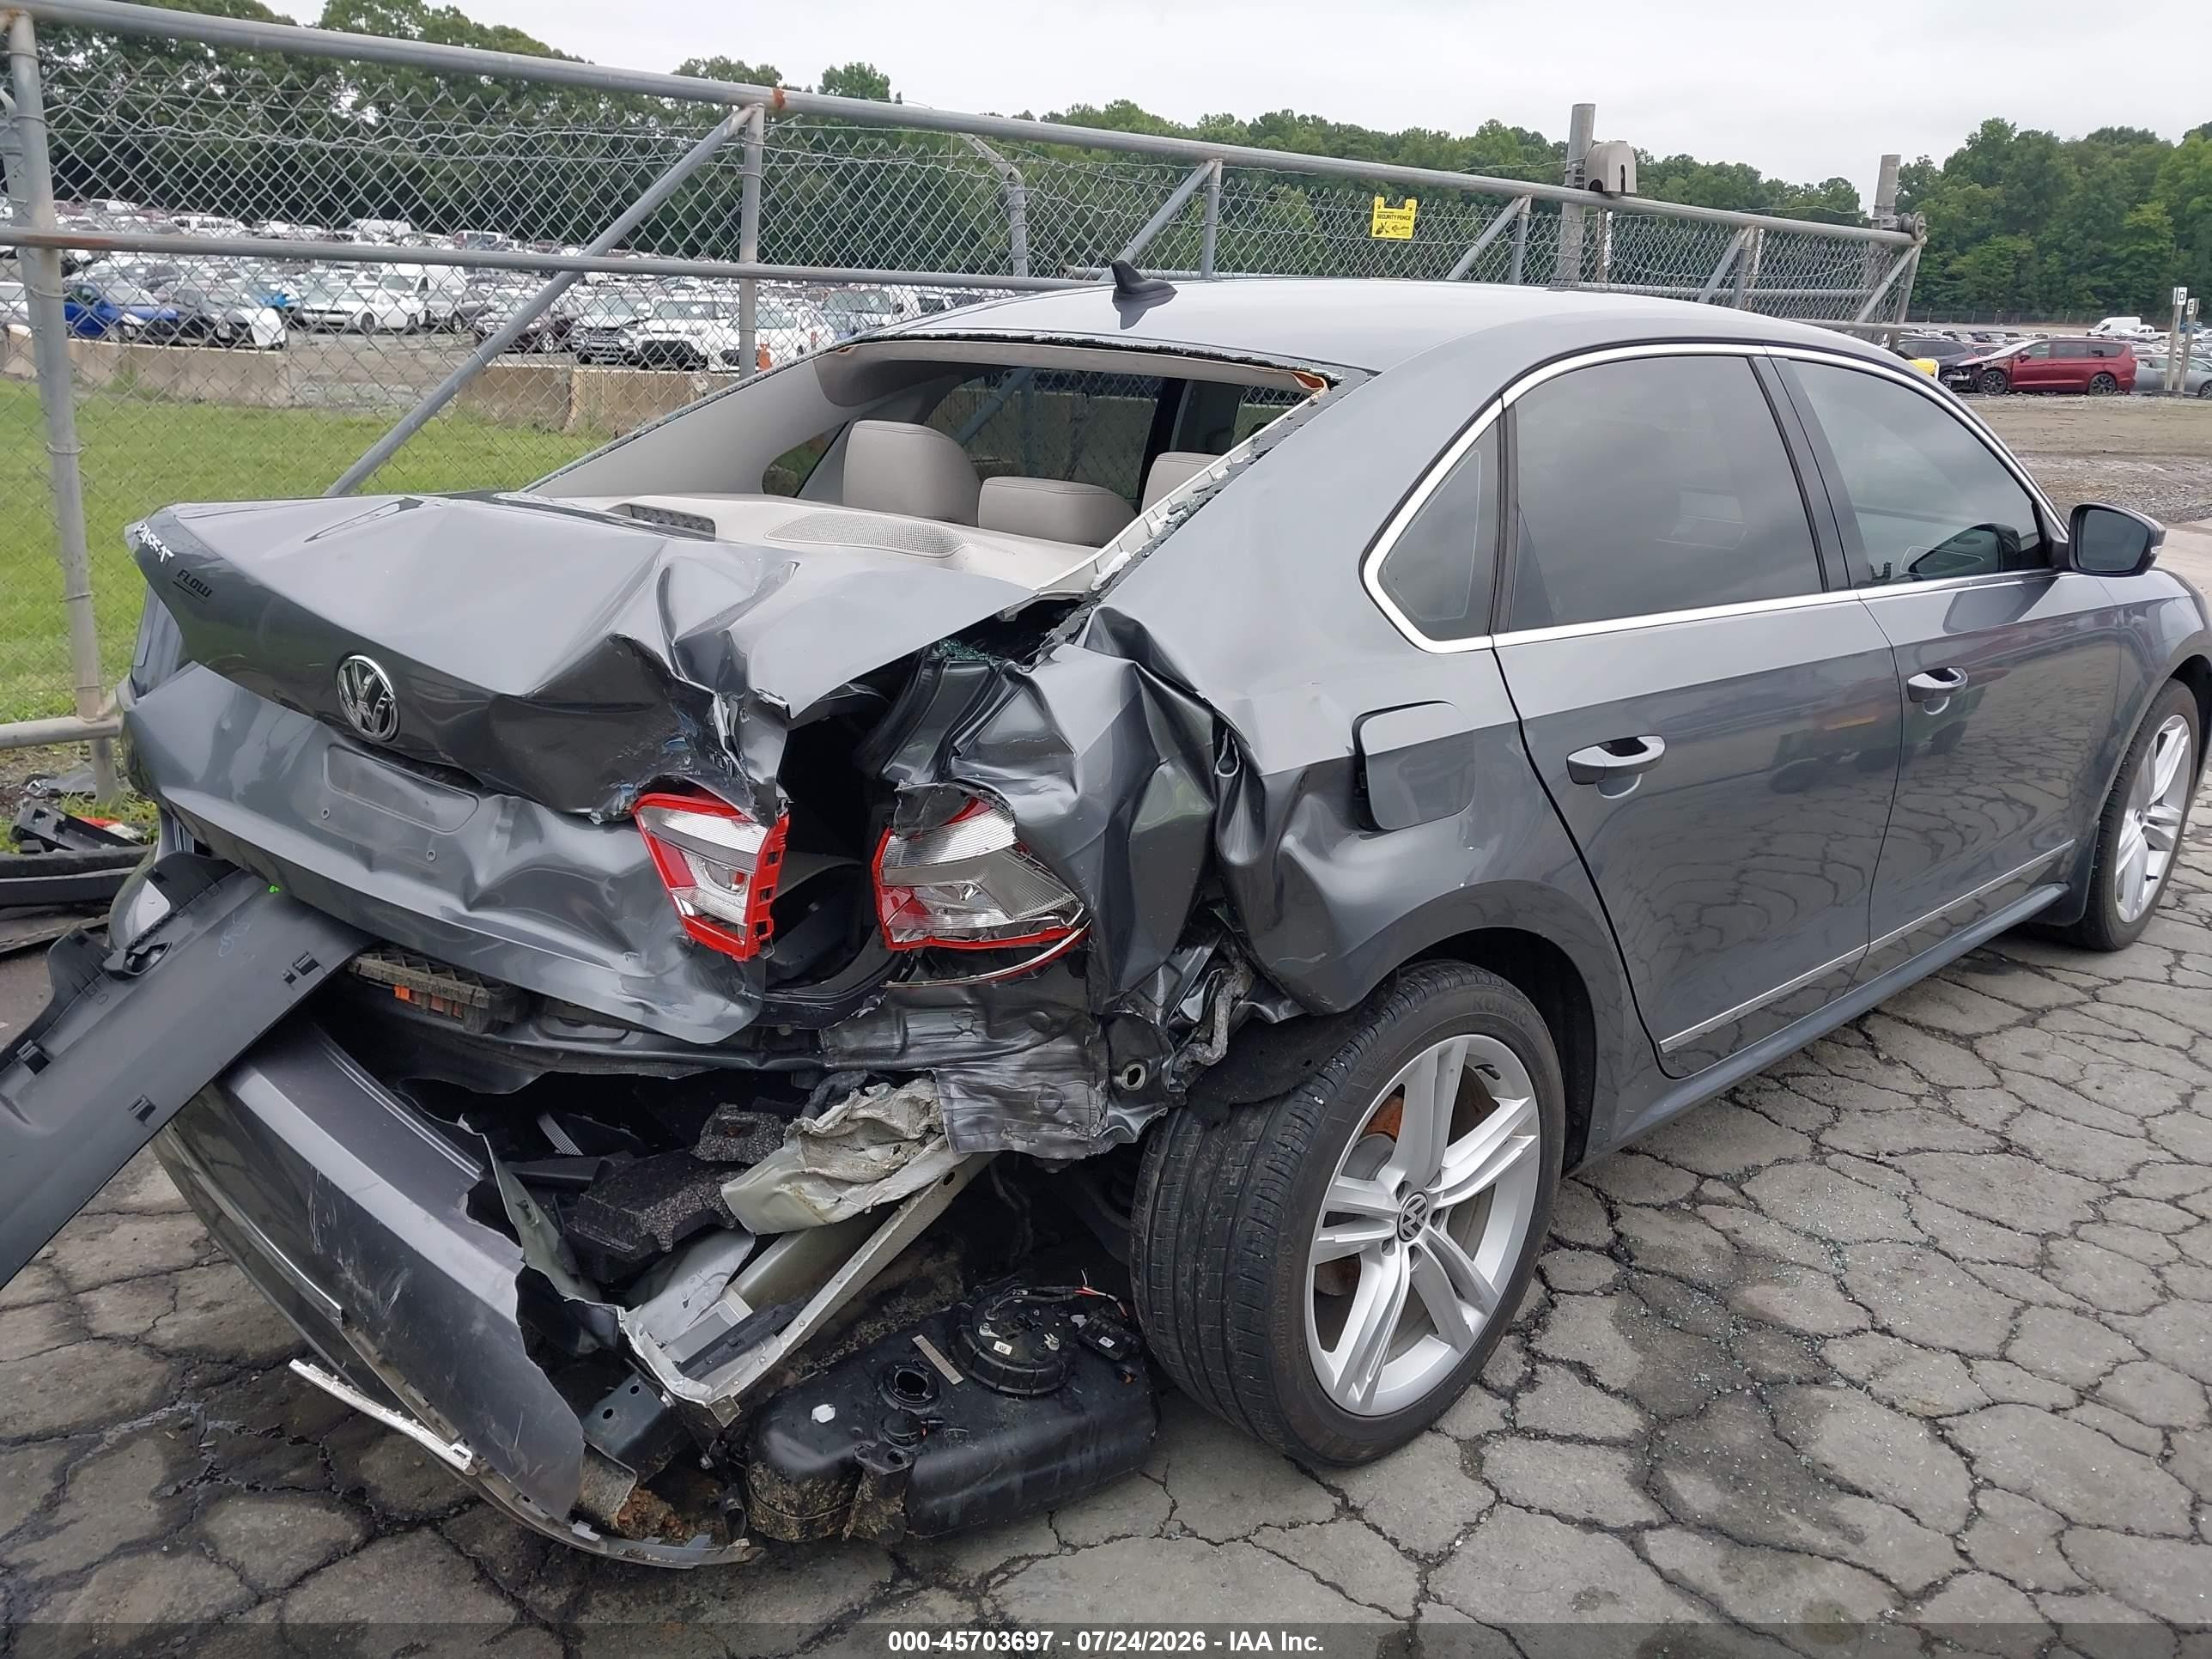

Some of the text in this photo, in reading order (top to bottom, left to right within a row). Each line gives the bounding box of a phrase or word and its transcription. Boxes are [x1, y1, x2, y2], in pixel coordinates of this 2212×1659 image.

[2179, 292, 2185, 301] D
[134, 521, 175, 566] PASSAT
[177, 568, 213, 599] FLOW
